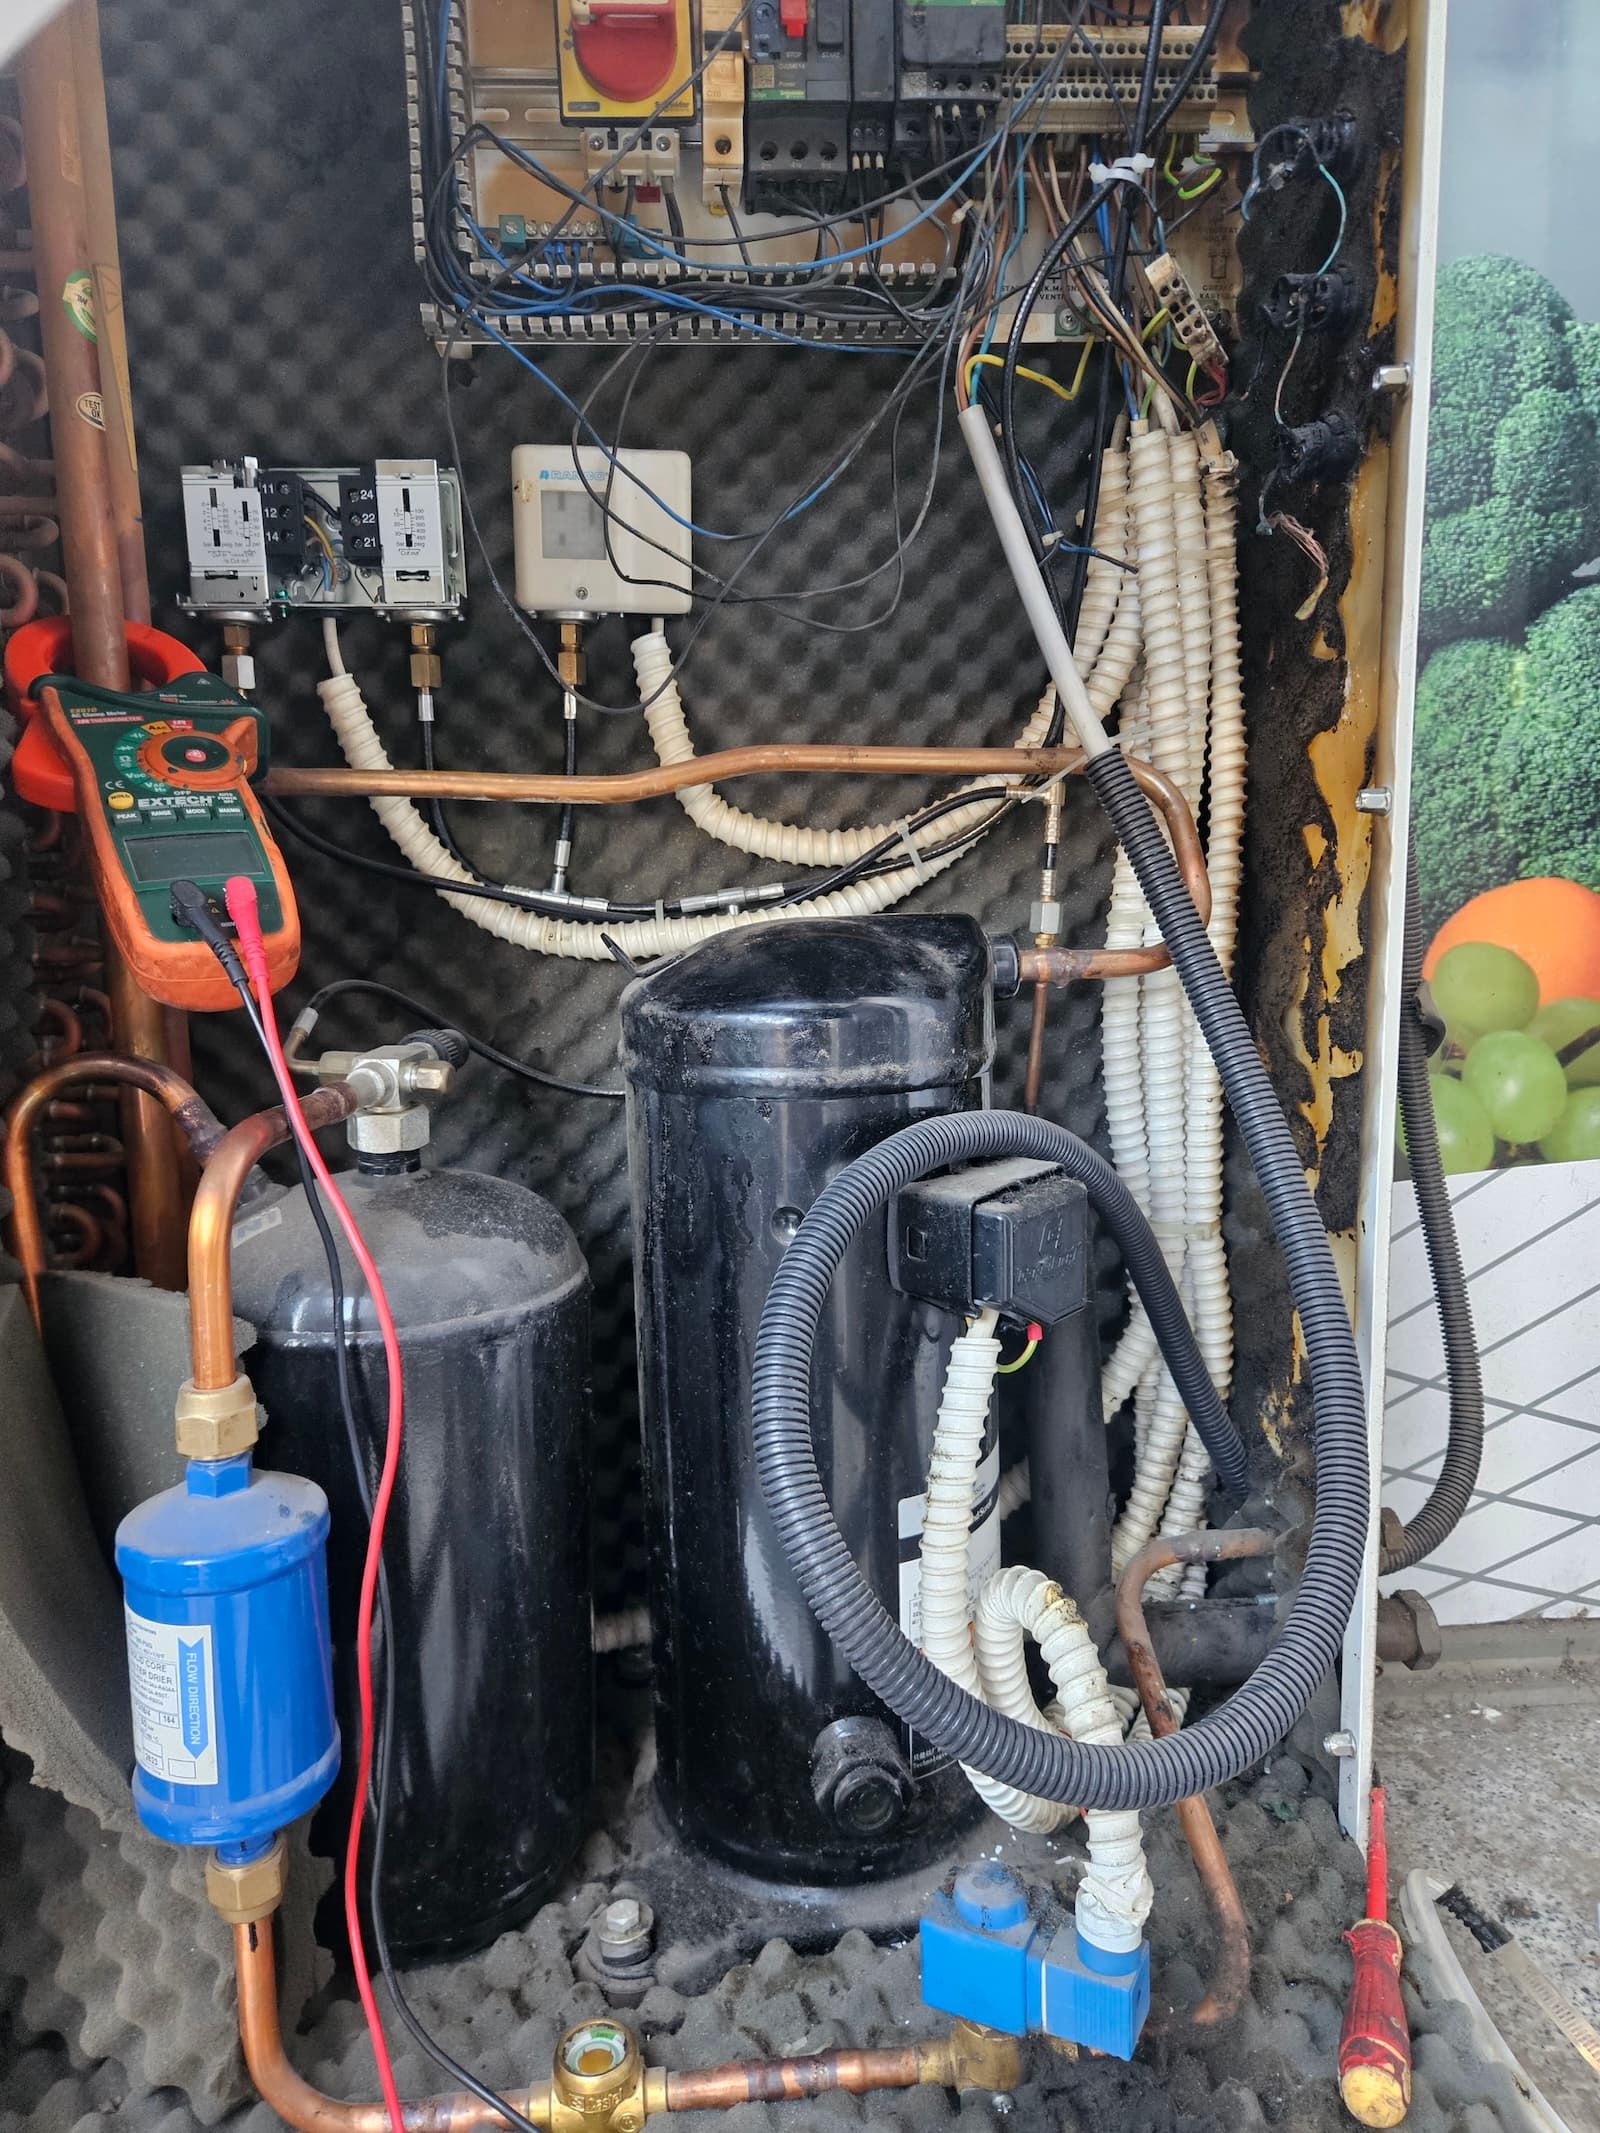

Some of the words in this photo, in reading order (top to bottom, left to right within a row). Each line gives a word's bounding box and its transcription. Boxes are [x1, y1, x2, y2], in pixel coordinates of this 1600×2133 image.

[84, 399, 101, 409] TEST
[262, 483, 274, 495] 11
[360, 489, 374, 500] 24
[264, 507, 278, 519] 12
[361, 513, 376, 524] 22
[265, 531, 279, 542] 14
[363, 537, 376, 548] 21
[137, 795, 214, 808] EXTECH
[145, 1659, 167, 1673] CORE
[186, 1652, 199, 1684] FLOW
[148, 1671, 173, 1685] DRIER
[187, 1686, 202, 1745] DIRECTION
